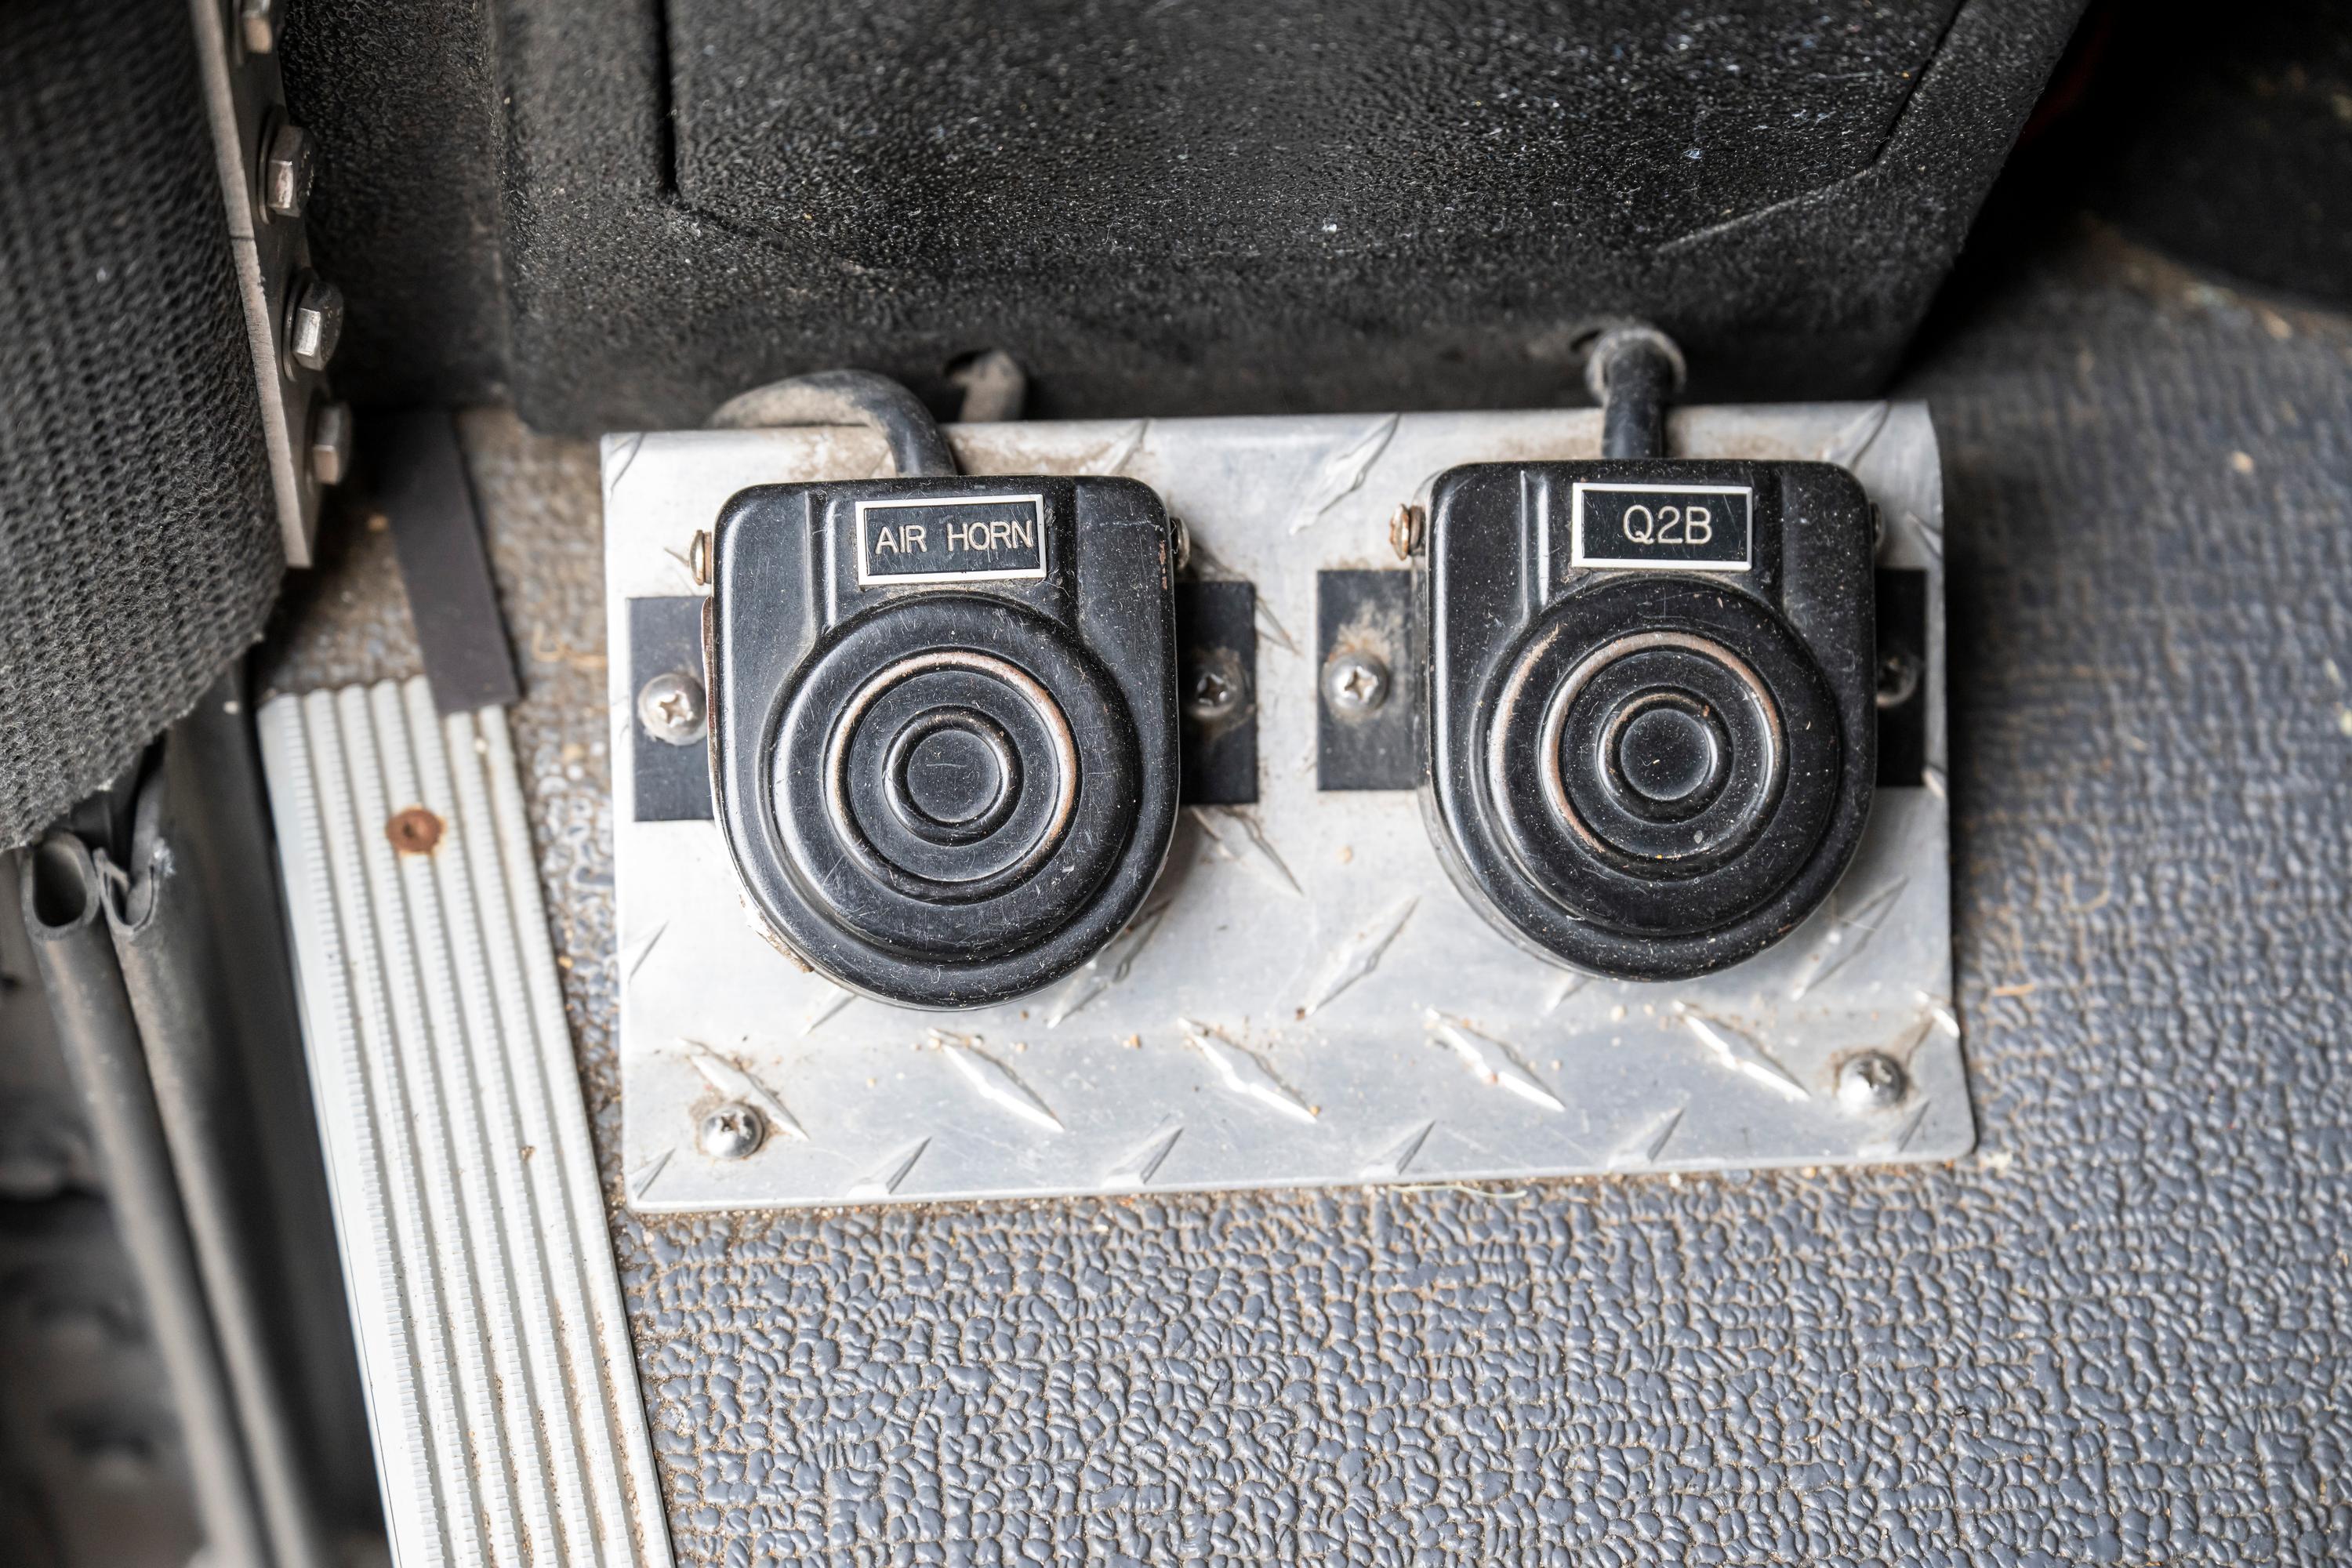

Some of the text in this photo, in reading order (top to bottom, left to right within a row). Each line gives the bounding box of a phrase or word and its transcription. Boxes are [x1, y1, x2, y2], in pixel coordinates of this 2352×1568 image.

[875, 519, 1033, 554] AIR HORN
[1623, 504, 1713, 545] Q2B
